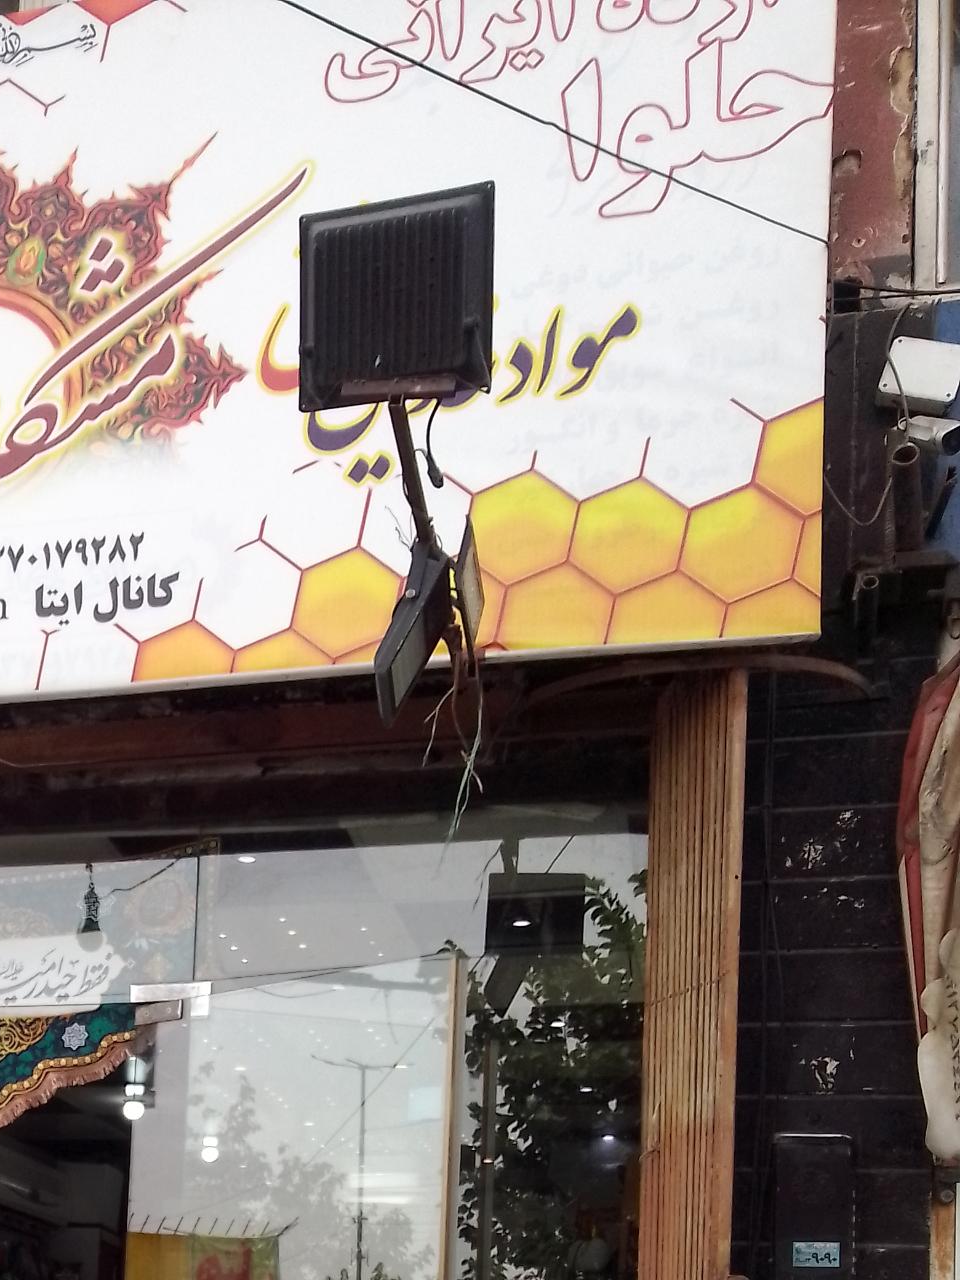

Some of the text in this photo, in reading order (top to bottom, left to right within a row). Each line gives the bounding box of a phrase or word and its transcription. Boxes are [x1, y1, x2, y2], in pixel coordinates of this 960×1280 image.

[561, 38, 836, 218] حلوا
[495, 302, 640, 404] مواد
[35, 572, 180, 632] کانال ایتا
